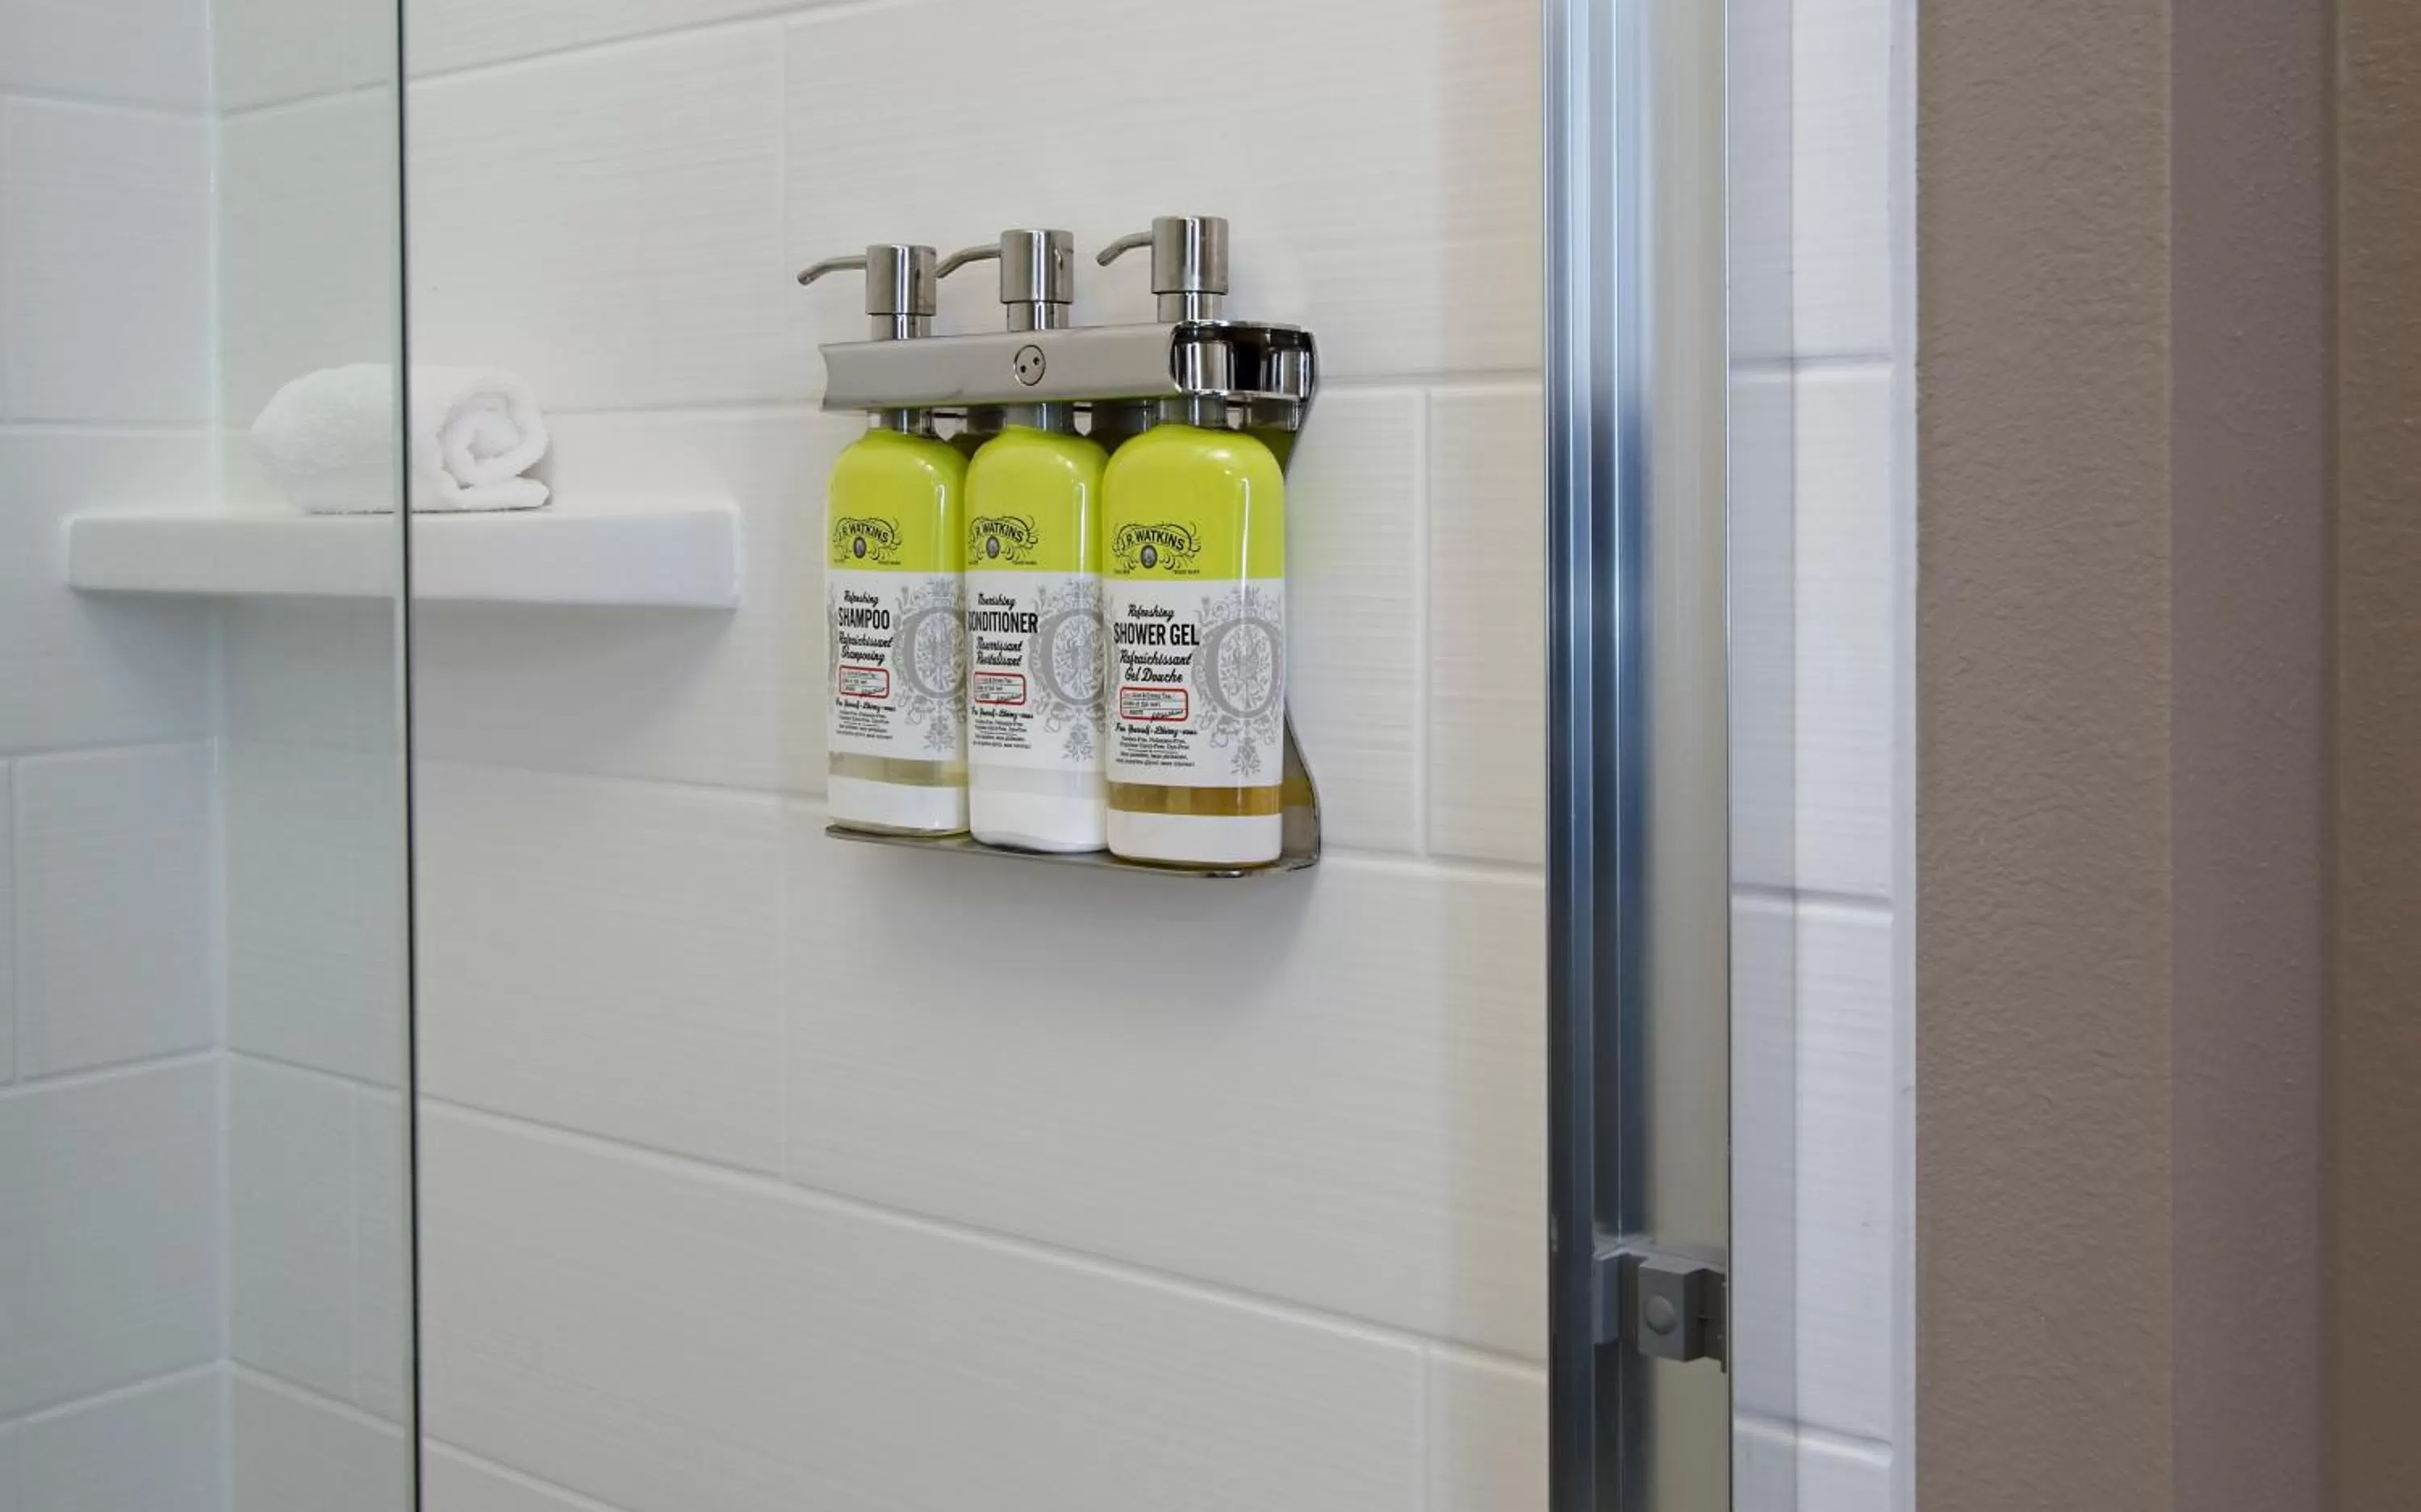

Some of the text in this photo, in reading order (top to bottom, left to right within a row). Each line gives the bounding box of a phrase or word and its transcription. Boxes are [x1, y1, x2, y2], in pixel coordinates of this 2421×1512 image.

[848, 521, 889, 543] WATKINS
[982, 522, 1023, 543] WATKINS
[1135, 529, 1185, 551] WATKINS
[838, 606, 890, 629] SHAMPOO
[968, 611, 1038, 633] CONDITIONER
[1128, 603, 1175, 622] Refreshing
[1114, 622, 1200, 646] SHOWER GEL
[1124, 666, 1183, 683] Gel Douche
